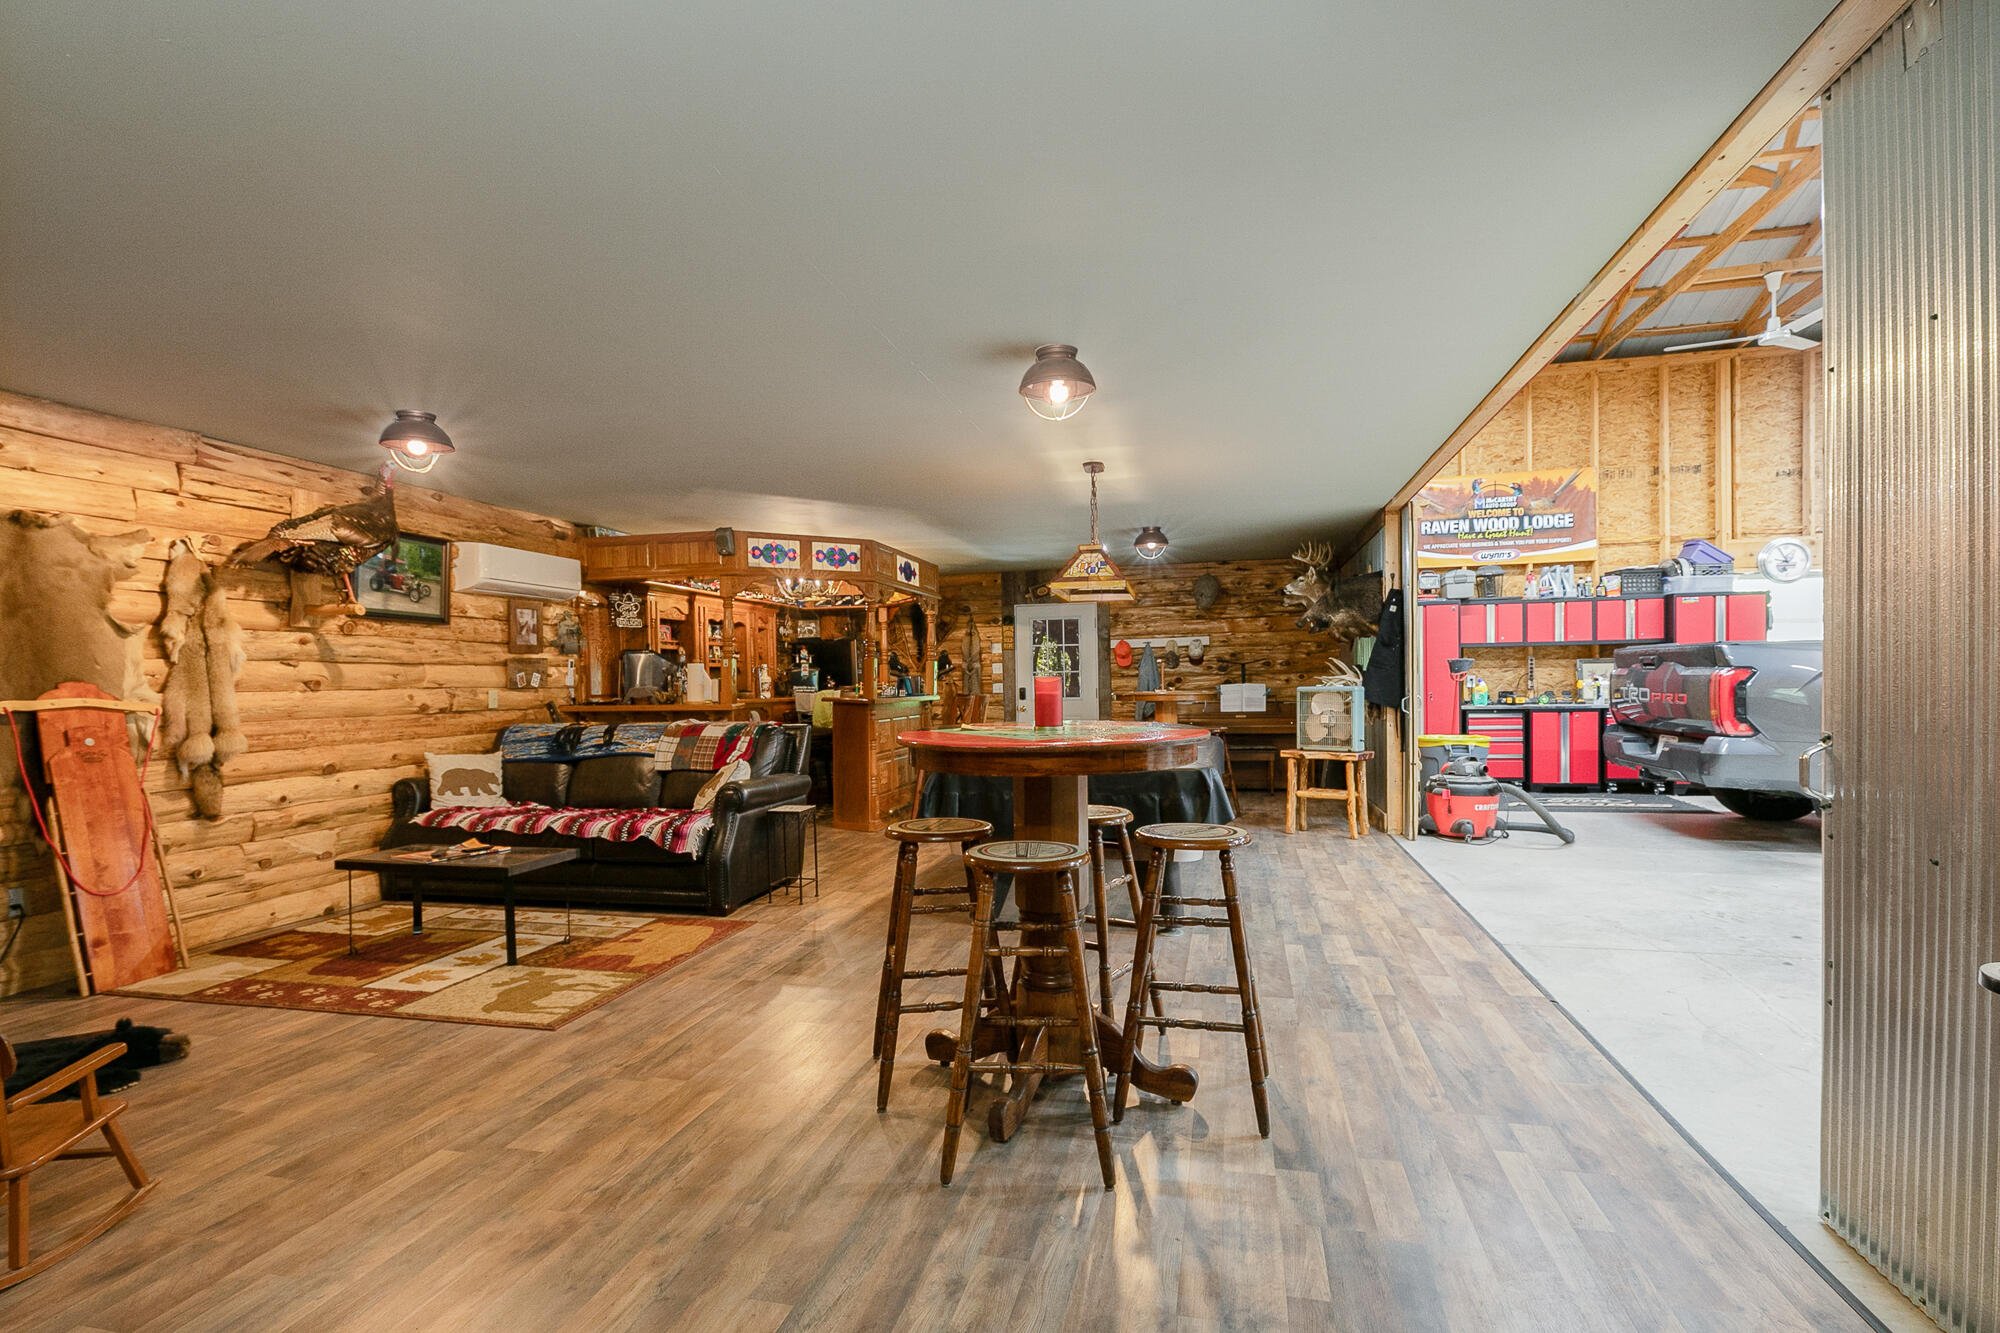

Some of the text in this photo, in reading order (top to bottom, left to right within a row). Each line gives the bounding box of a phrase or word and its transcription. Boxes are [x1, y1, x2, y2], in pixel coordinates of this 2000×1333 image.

[1468, 507, 1524, 518] WELCOME TO
[1420, 513, 1574, 535] RAVEN WOOD LODGE
[1457, 531, 1476, 540] Have
[1484, 529, 1508, 540] Great
[1508, 528, 1533, 538] Hunt!
[1650, 692, 1688, 705] PRO
